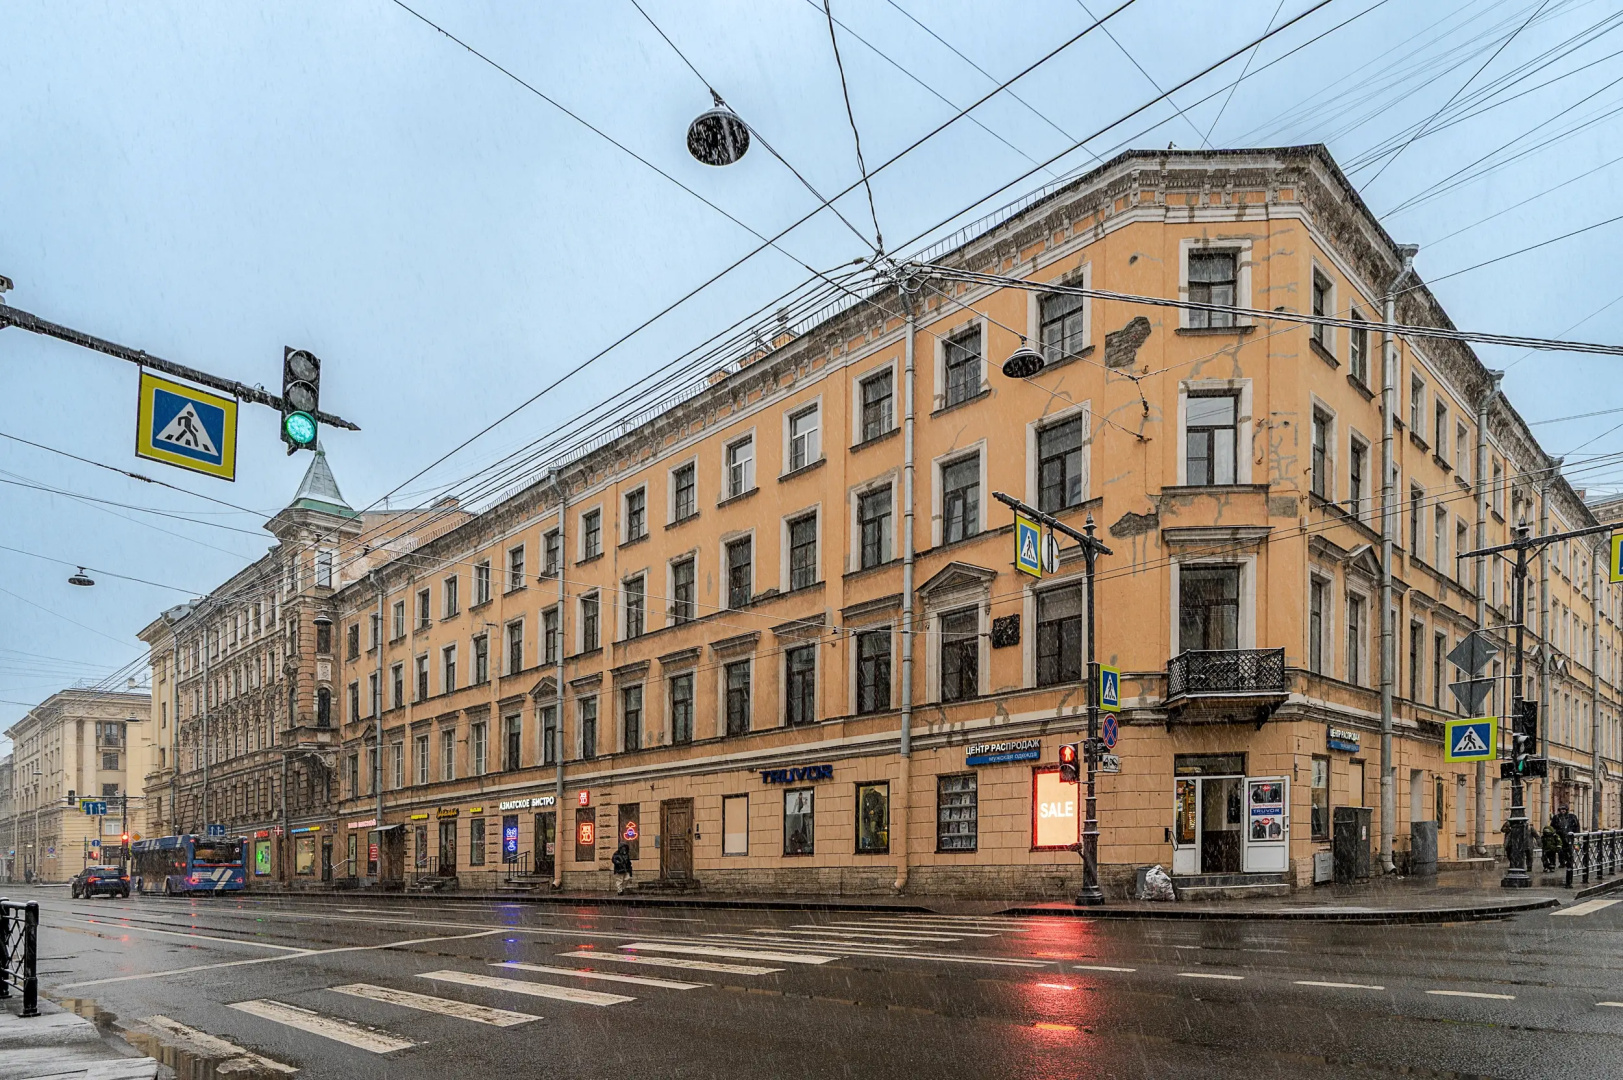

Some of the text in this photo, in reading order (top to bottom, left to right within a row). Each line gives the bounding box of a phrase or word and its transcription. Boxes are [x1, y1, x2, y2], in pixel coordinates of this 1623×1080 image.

[966, 739, 1040, 756] ЦЕНТР РАСПРОДАЖ
[759, 764, 834, 784] TRUVOR
[499, 796, 555, 810] АЗИАТСКОЕ БИСТРО
[1040, 801, 1074, 818] SALE
